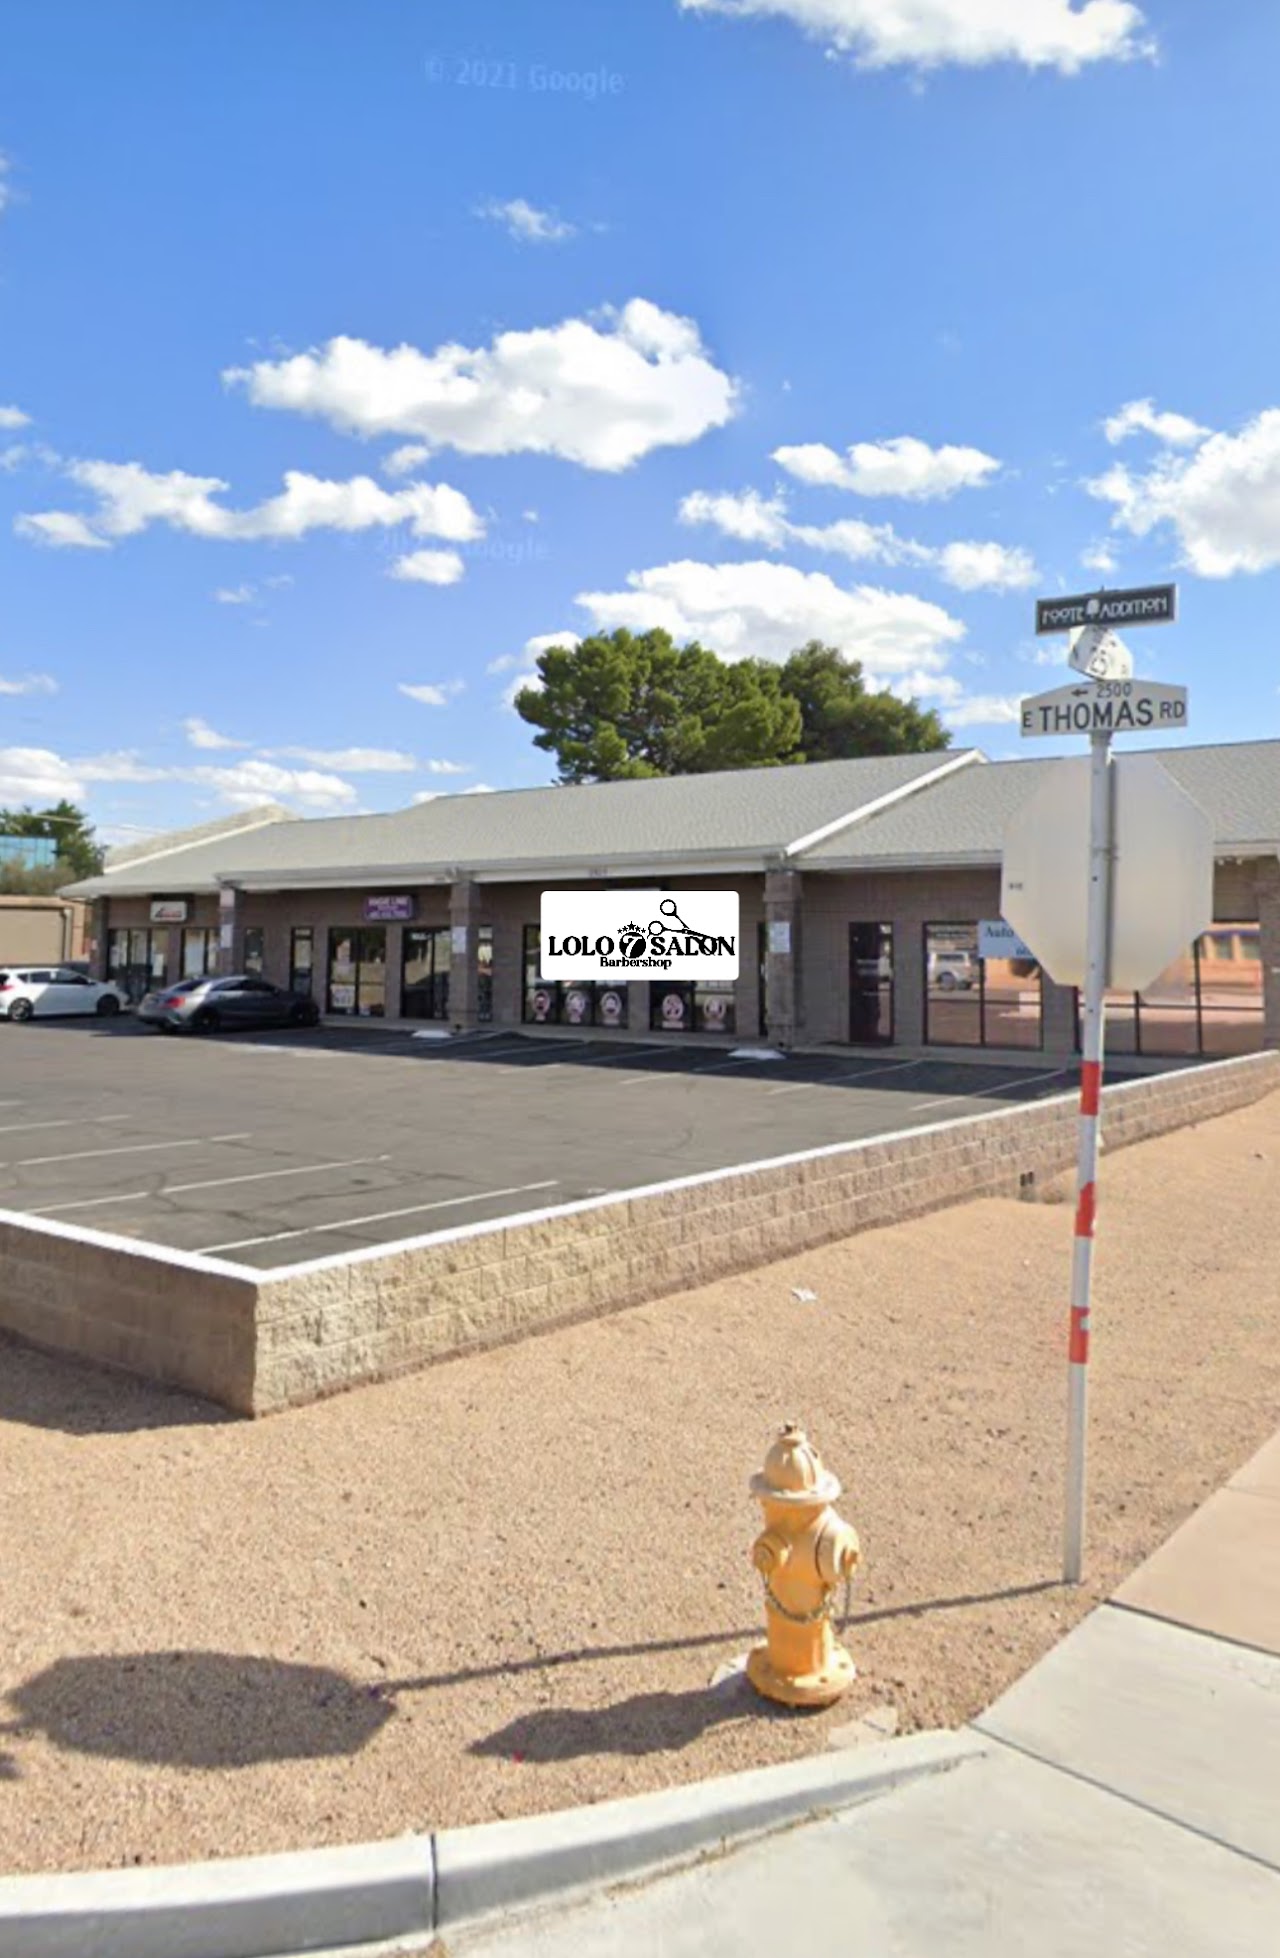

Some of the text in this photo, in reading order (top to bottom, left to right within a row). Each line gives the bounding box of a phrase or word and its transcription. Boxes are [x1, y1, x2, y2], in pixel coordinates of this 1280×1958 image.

[1099, 597, 1168, 619] ADDITION
[1096, 683, 1133, 697] 2500
[1023, 699, 1186, 732] E THOMAS RD
[985, 926, 1014, 938] Auto
